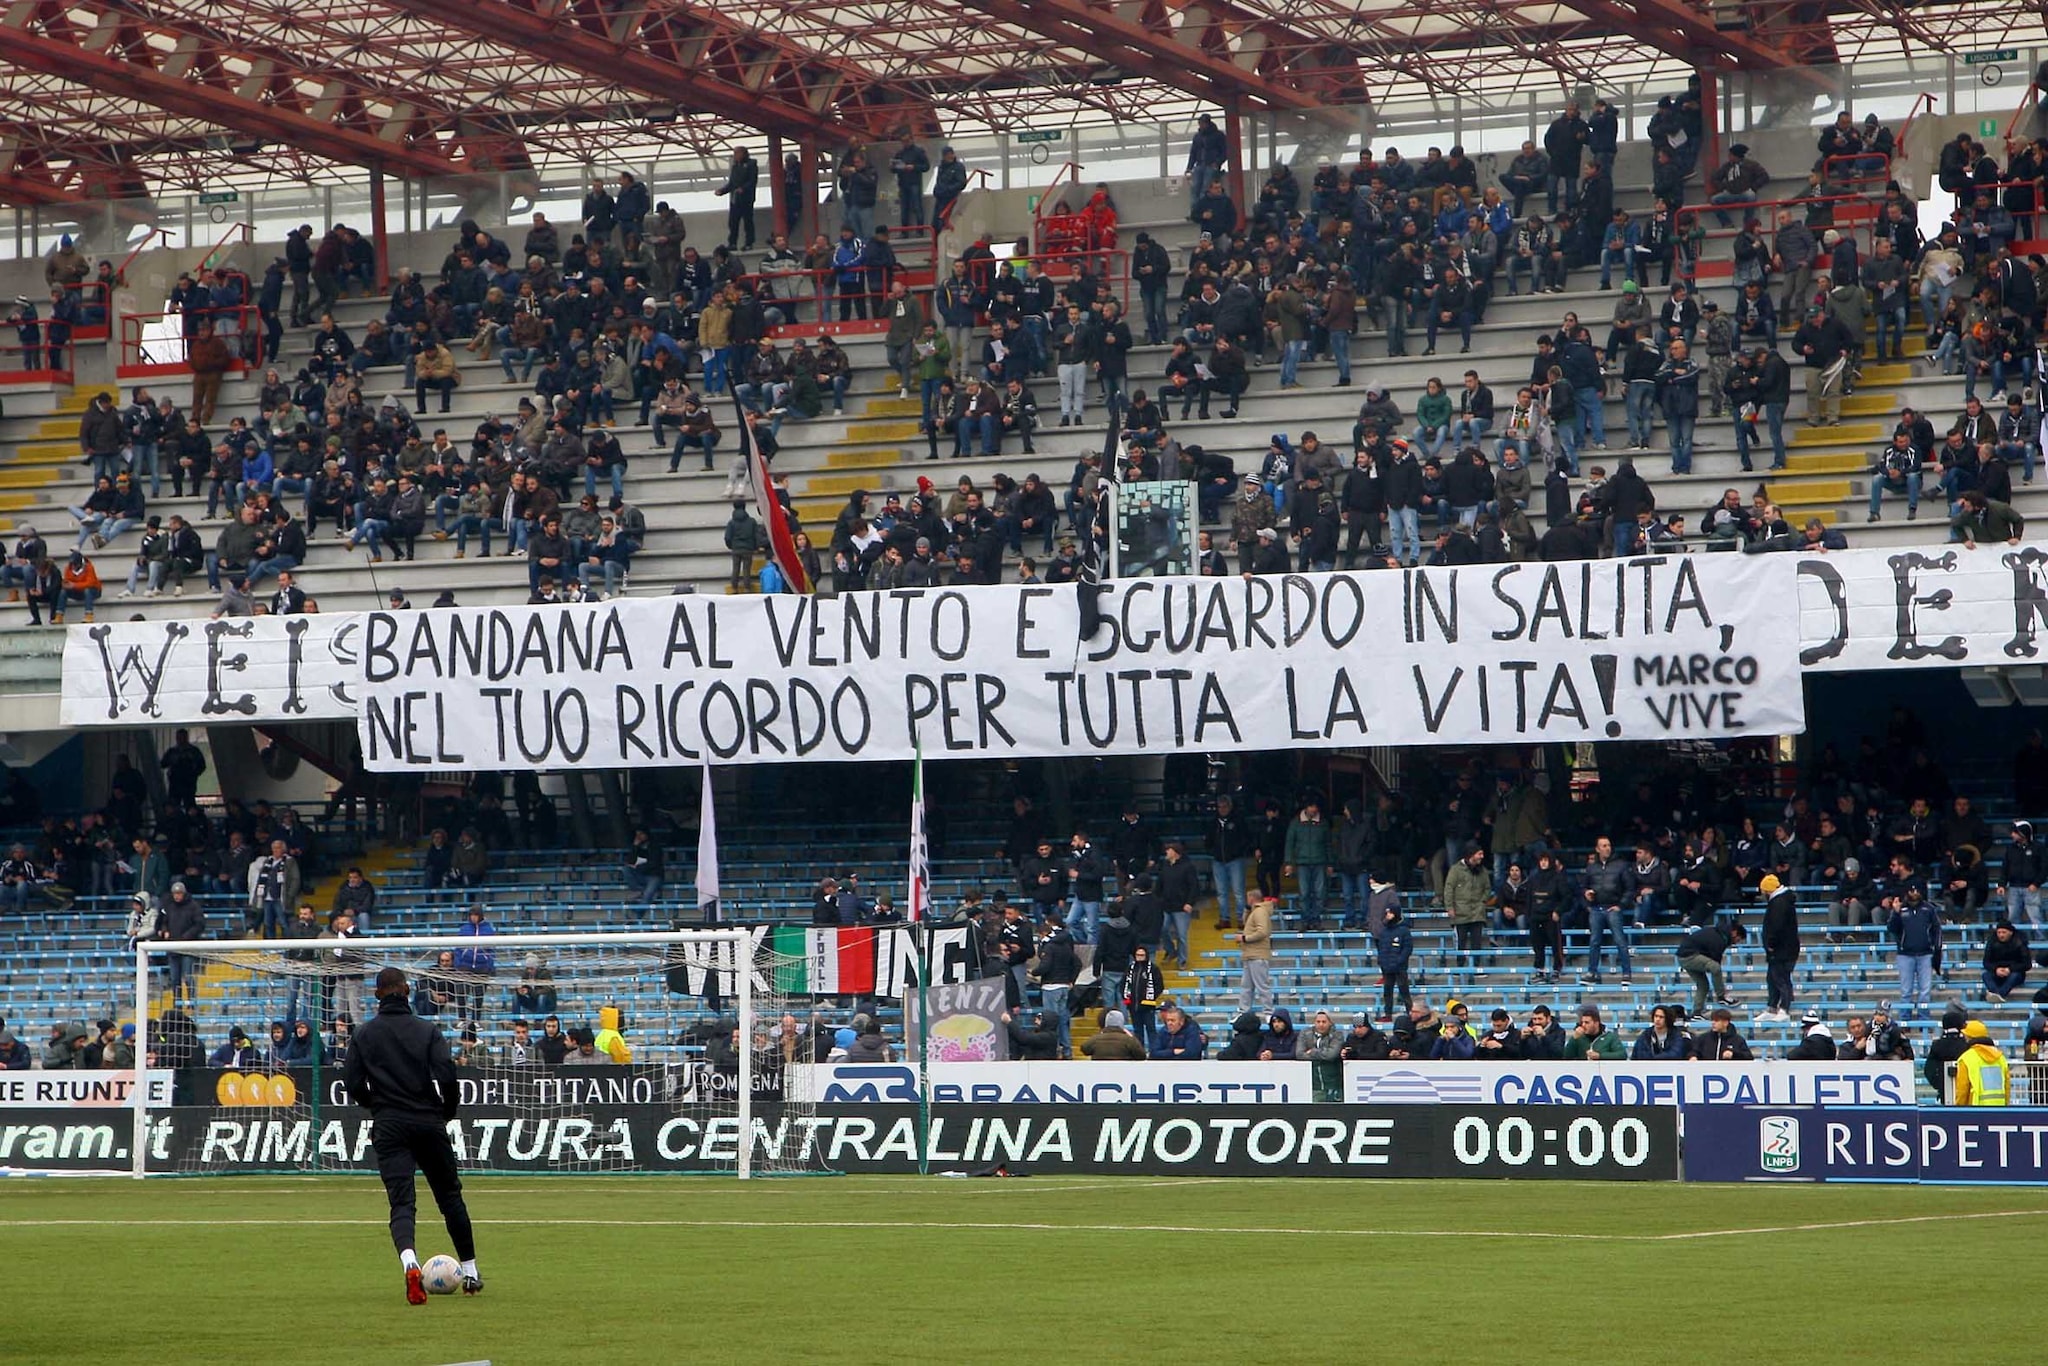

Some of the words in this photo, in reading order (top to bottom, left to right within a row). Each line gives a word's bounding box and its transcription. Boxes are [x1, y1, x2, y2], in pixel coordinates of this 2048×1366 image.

[365, 606, 633, 682] BANDANA
[663, 601, 733, 669] AL
[764, 590, 971, 668] VENTO
[1016, 588, 1053, 658] E
[1087, 574, 1365, 662] SGUARDO
[1403, 569, 1458, 643] IN
[1491, 557, 1735, 653] SALITA,
[1634, 655, 1758, 686] MARCO
[367, 691, 464, 764] NEL
[480, 687, 590, 763] TUO
[615, 676, 871, 760] RICORDO
[906, 673, 1016, 750] PER
[1045, 669, 1242, 748] TUTTA
[1285, 666, 1368, 739] LA
[1412, 654, 1622, 738] VITA!
[1645, 692, 1745, 729] VIVE
[36, 1081, 163, 1101] RIUNIE
[457, 1079, 518, 1106] DEL
[533, 1077, 651, 1104] TITANO
[701, 1071, 780, 1092] ROMGNA
[934, 1083, 1288, 1103] BRANCHETTI
[1494, 1074, 1686, 1105] CASADEI
[1703, 1074, 1901, 1105] PALLETS
[201, 1117, 635, 1163] RIMAATURA
[656, 1117, 1074, 1162] CENTRALINA
[1093, 1118, 1395, 1164] MOTORE
[1453, 1116, 1650, 1167] 00:00
[1826, 1123, 2048, 1168] RISPETT
[1766, 1157, 1794, 1167] LNPB
